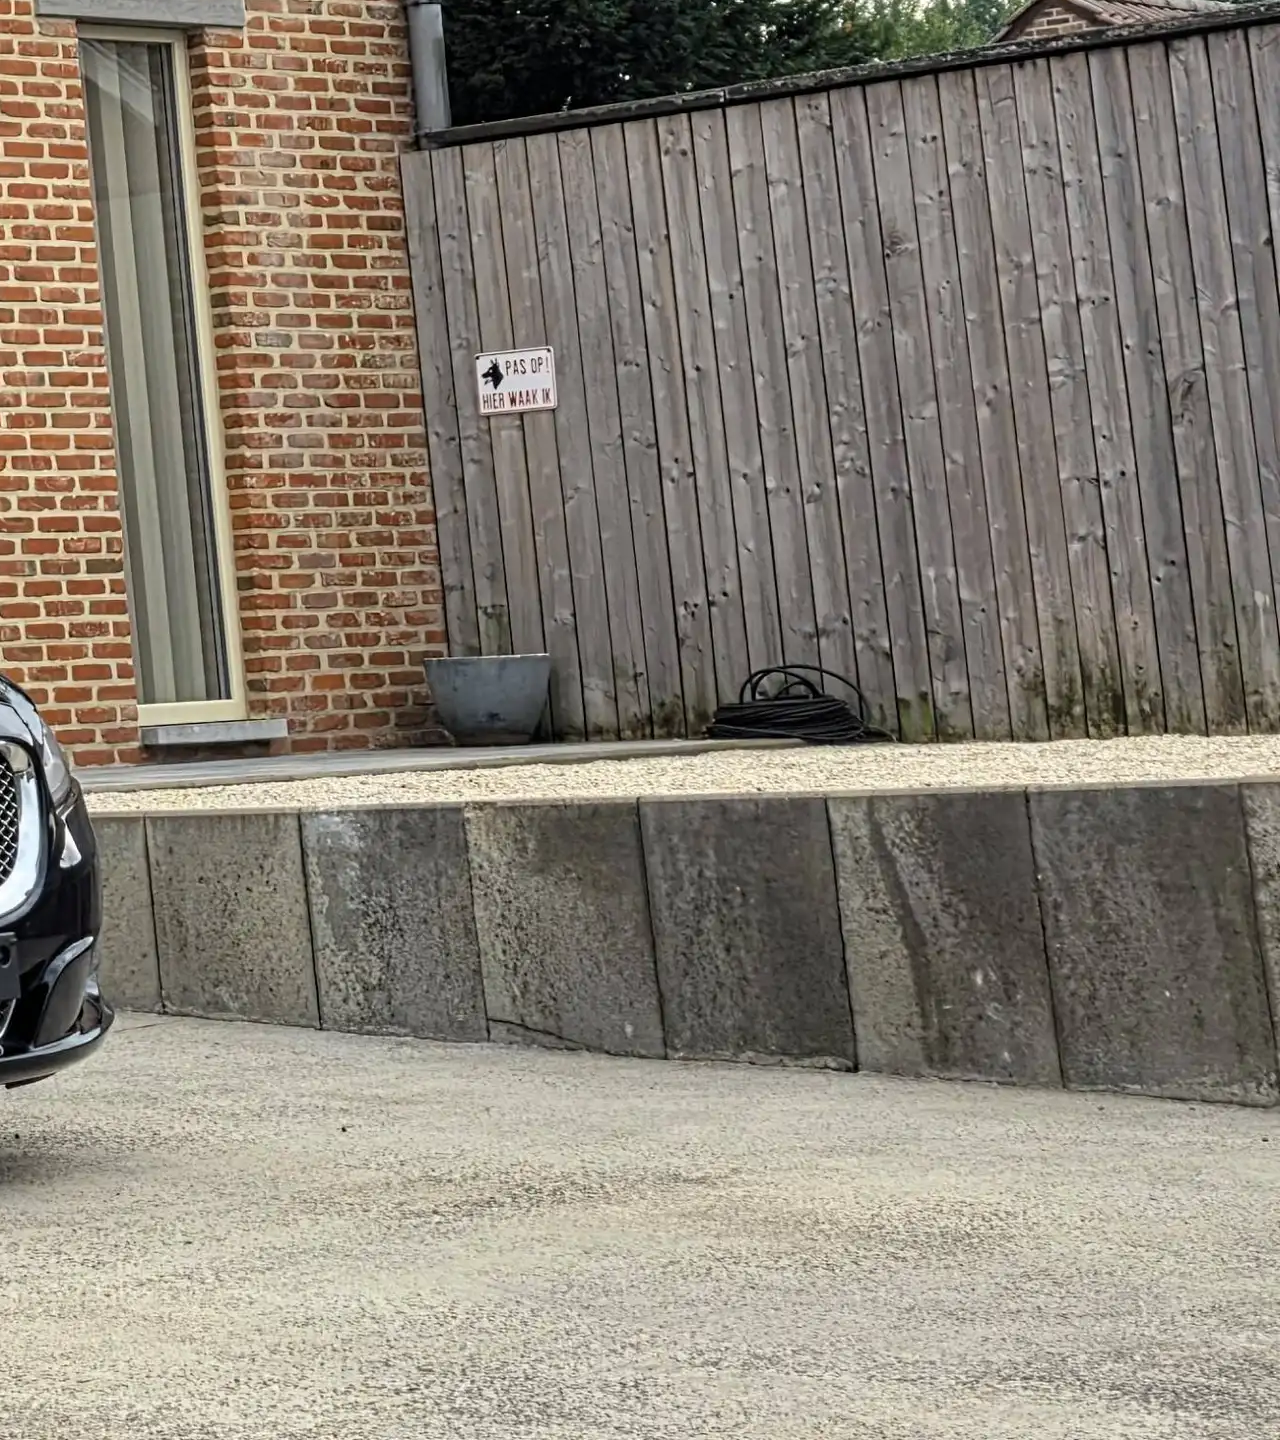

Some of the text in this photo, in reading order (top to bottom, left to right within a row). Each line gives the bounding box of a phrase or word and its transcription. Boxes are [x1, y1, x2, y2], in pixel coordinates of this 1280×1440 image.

[505, 356, 550, 376] PAS OP!
[482, 387, 552, 410] HIER WAAK IK
